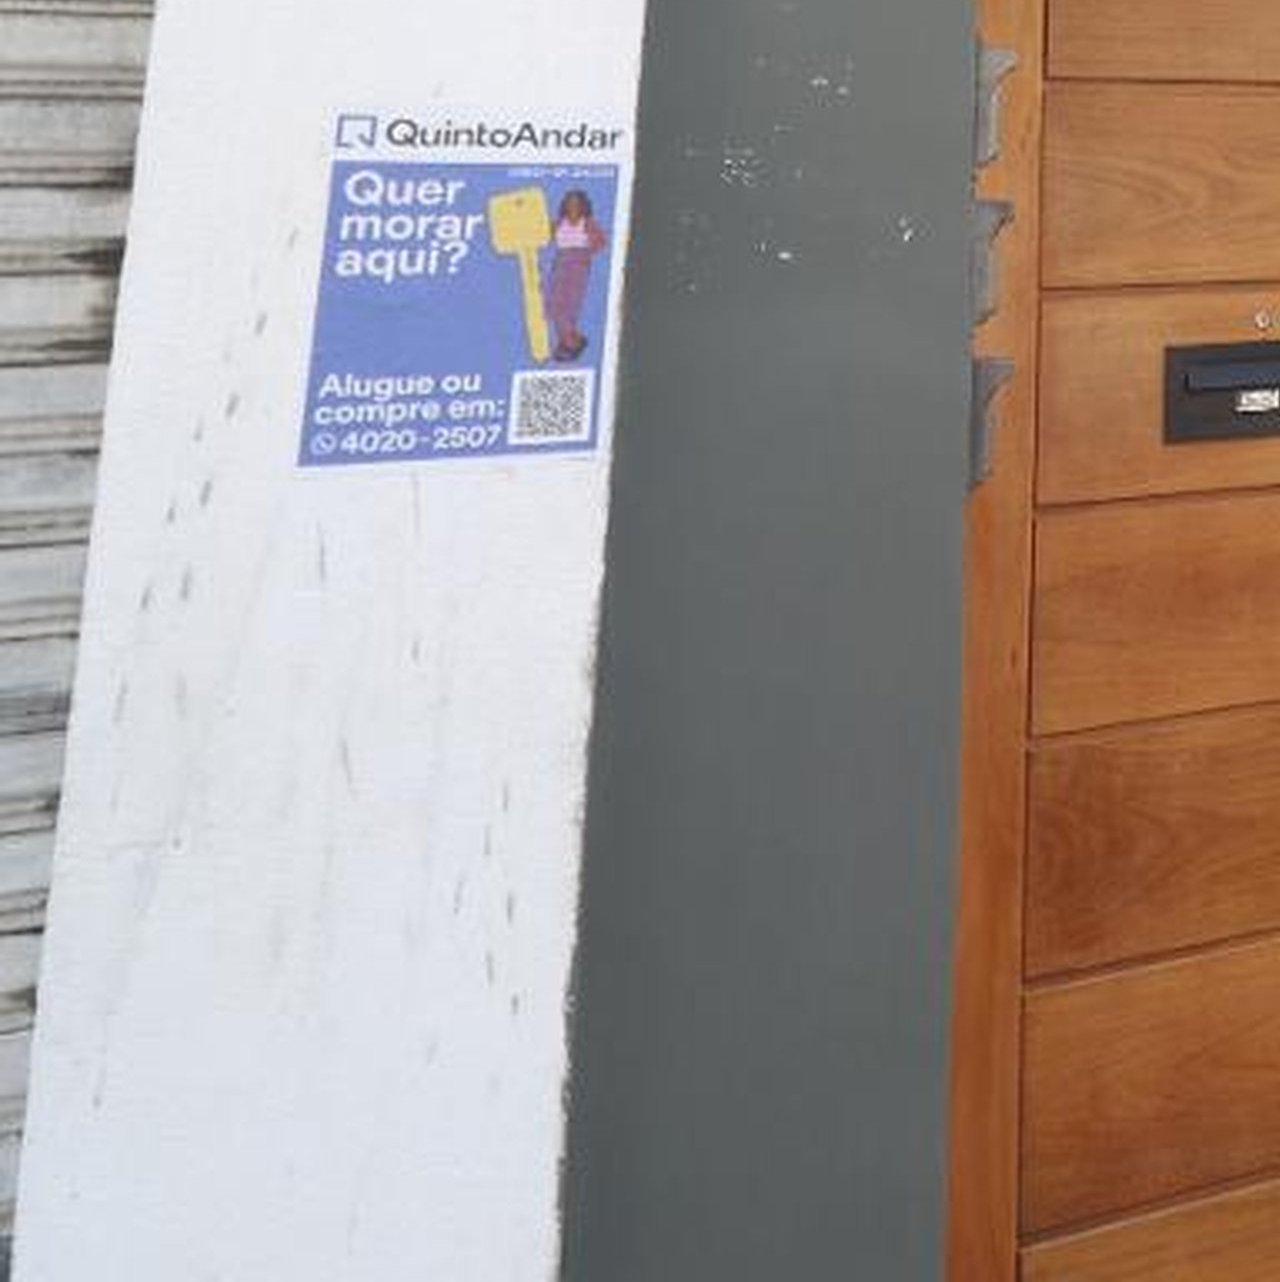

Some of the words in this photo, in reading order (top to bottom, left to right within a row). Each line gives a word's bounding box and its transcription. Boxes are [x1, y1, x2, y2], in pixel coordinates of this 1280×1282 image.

[385, 119, 623, 148] QuintoAndar
[344, 170, 466, 205] Quer
[339, 211, 485, 241] morar
[335, 240, 469, 282] aqui?
[318, 373, 434, 401] Alugue
[441, 373, 481, 393] ou
[314, 399, 440, 426] compre
[447, 397, 505, 418] em:
